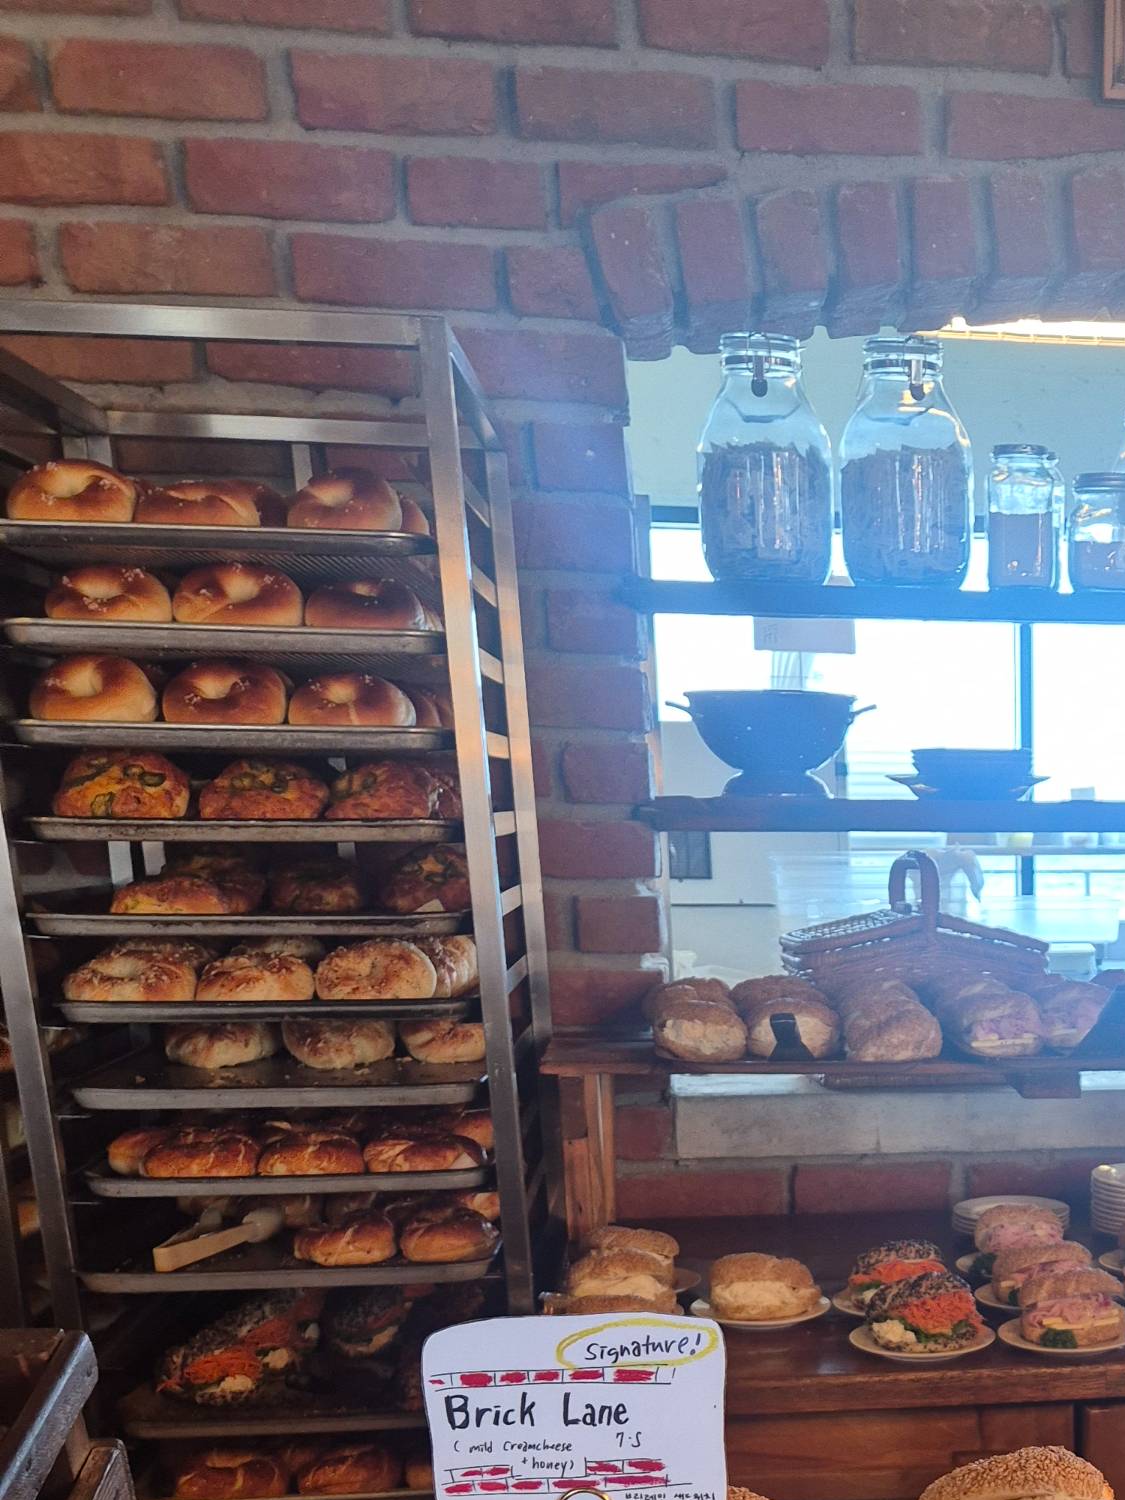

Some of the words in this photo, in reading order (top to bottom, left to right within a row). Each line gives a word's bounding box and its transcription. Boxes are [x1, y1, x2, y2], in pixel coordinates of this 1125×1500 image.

[585, 1333, 702, 1364] Signature!
[444, 1391, 536, 1430] Brick
[562, 1391, 630, 1427] Lane
